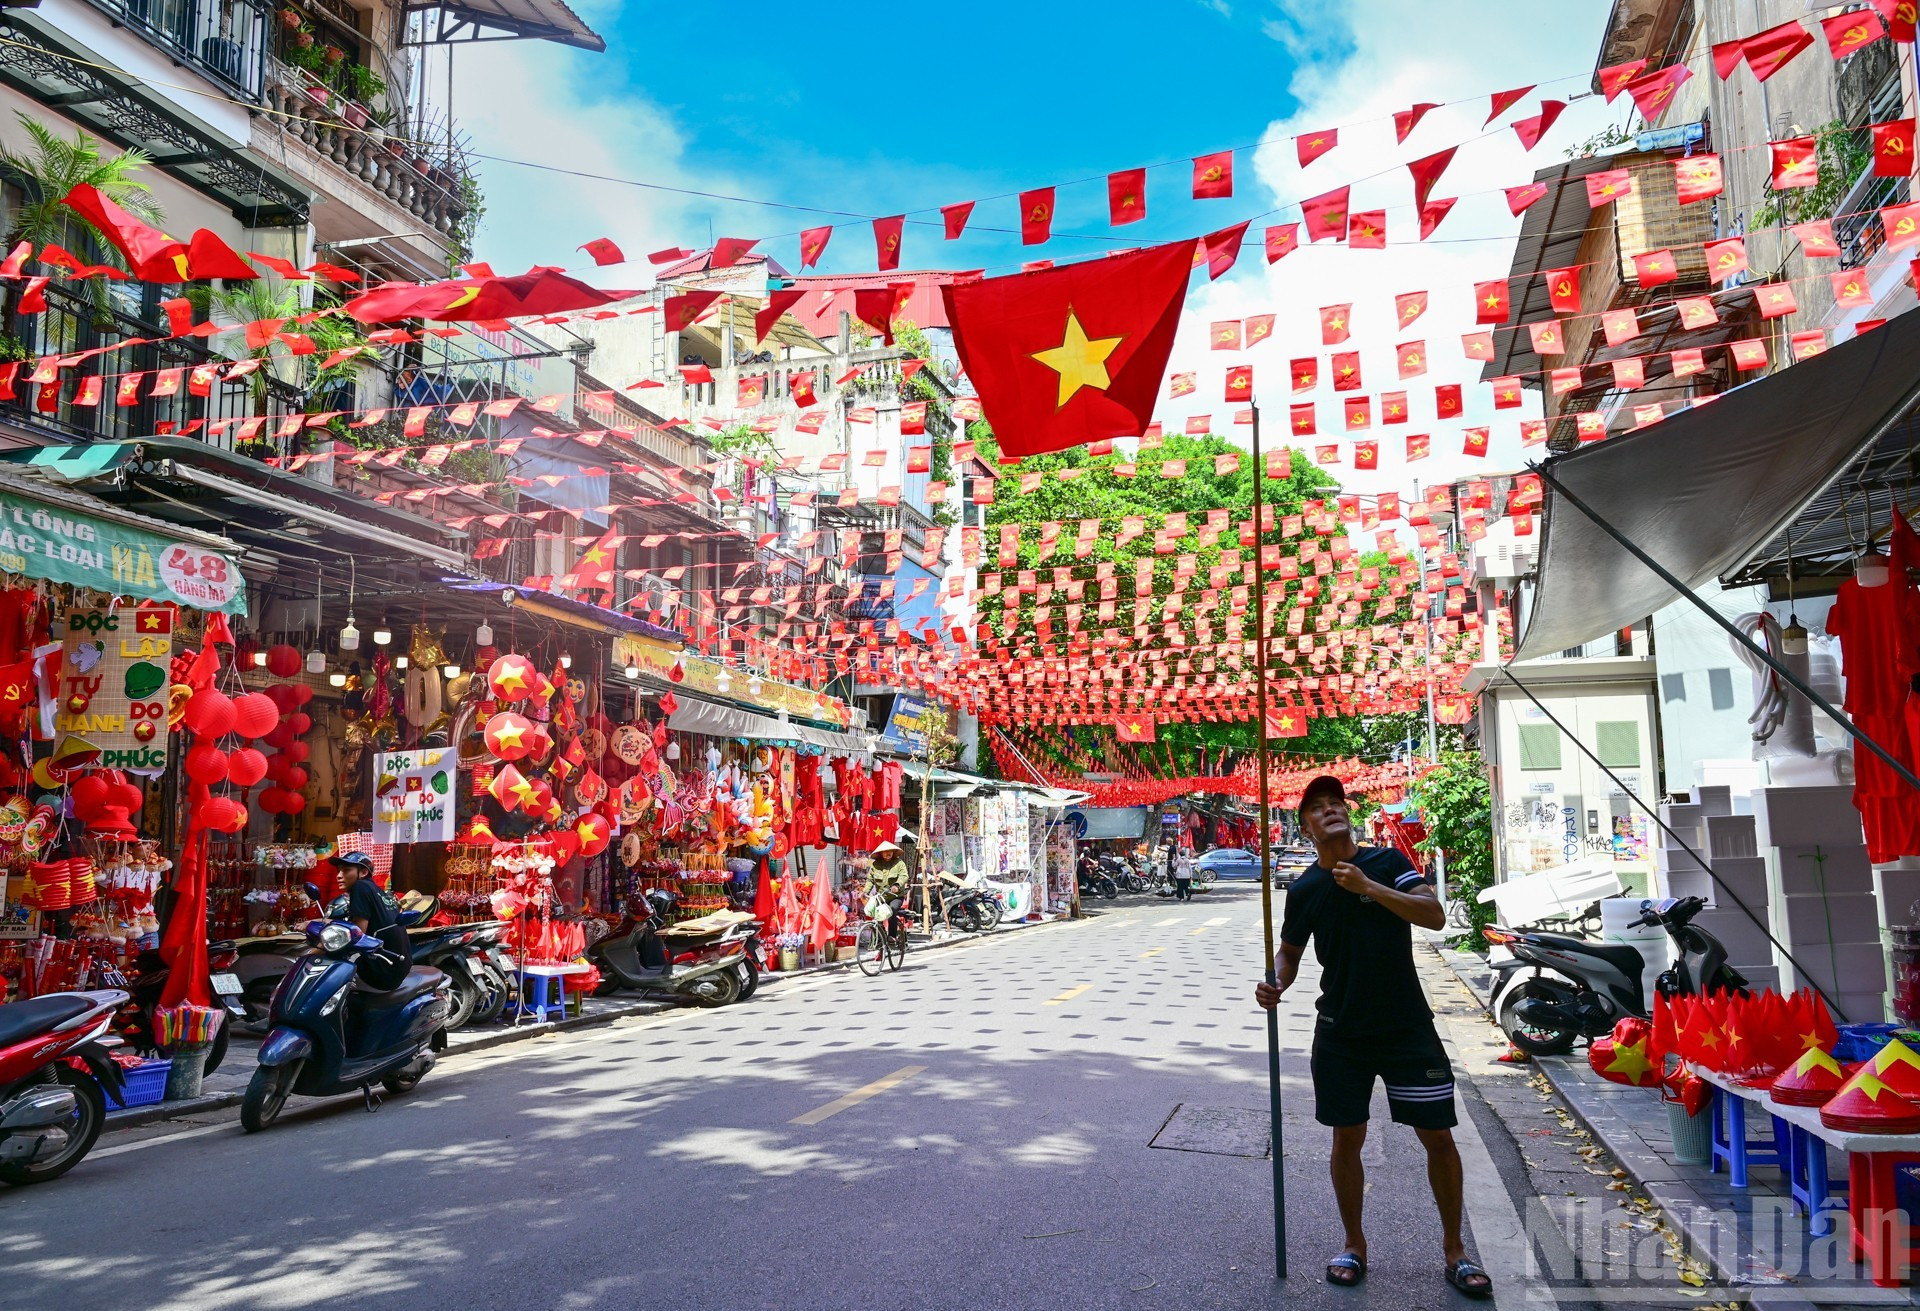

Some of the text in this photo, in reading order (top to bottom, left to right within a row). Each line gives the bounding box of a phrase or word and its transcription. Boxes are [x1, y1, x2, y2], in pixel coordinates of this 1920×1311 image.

[45, 540, 104, 570] LOẠI
[111, 544, 157, 588] HÀ
[168, 548, 227, 584] 48
[174, 579, 227, 603] HÀNG MÃ
[69, 610, 119, 636] ĐỘC
[119, 636, 171, 660] LẬP
[66, 674, 103, 699] TỰ
[130, 702, 164, 719] DO
[55, 714, 126, 736] HẠNH
[102, 745, 165, 767] PHÚC
[387, 751, 442, 772] ĐỘC LẬP
[389, 793, 434, 810] TỰ DO
[416, 807, 443, 821] PHÚC
